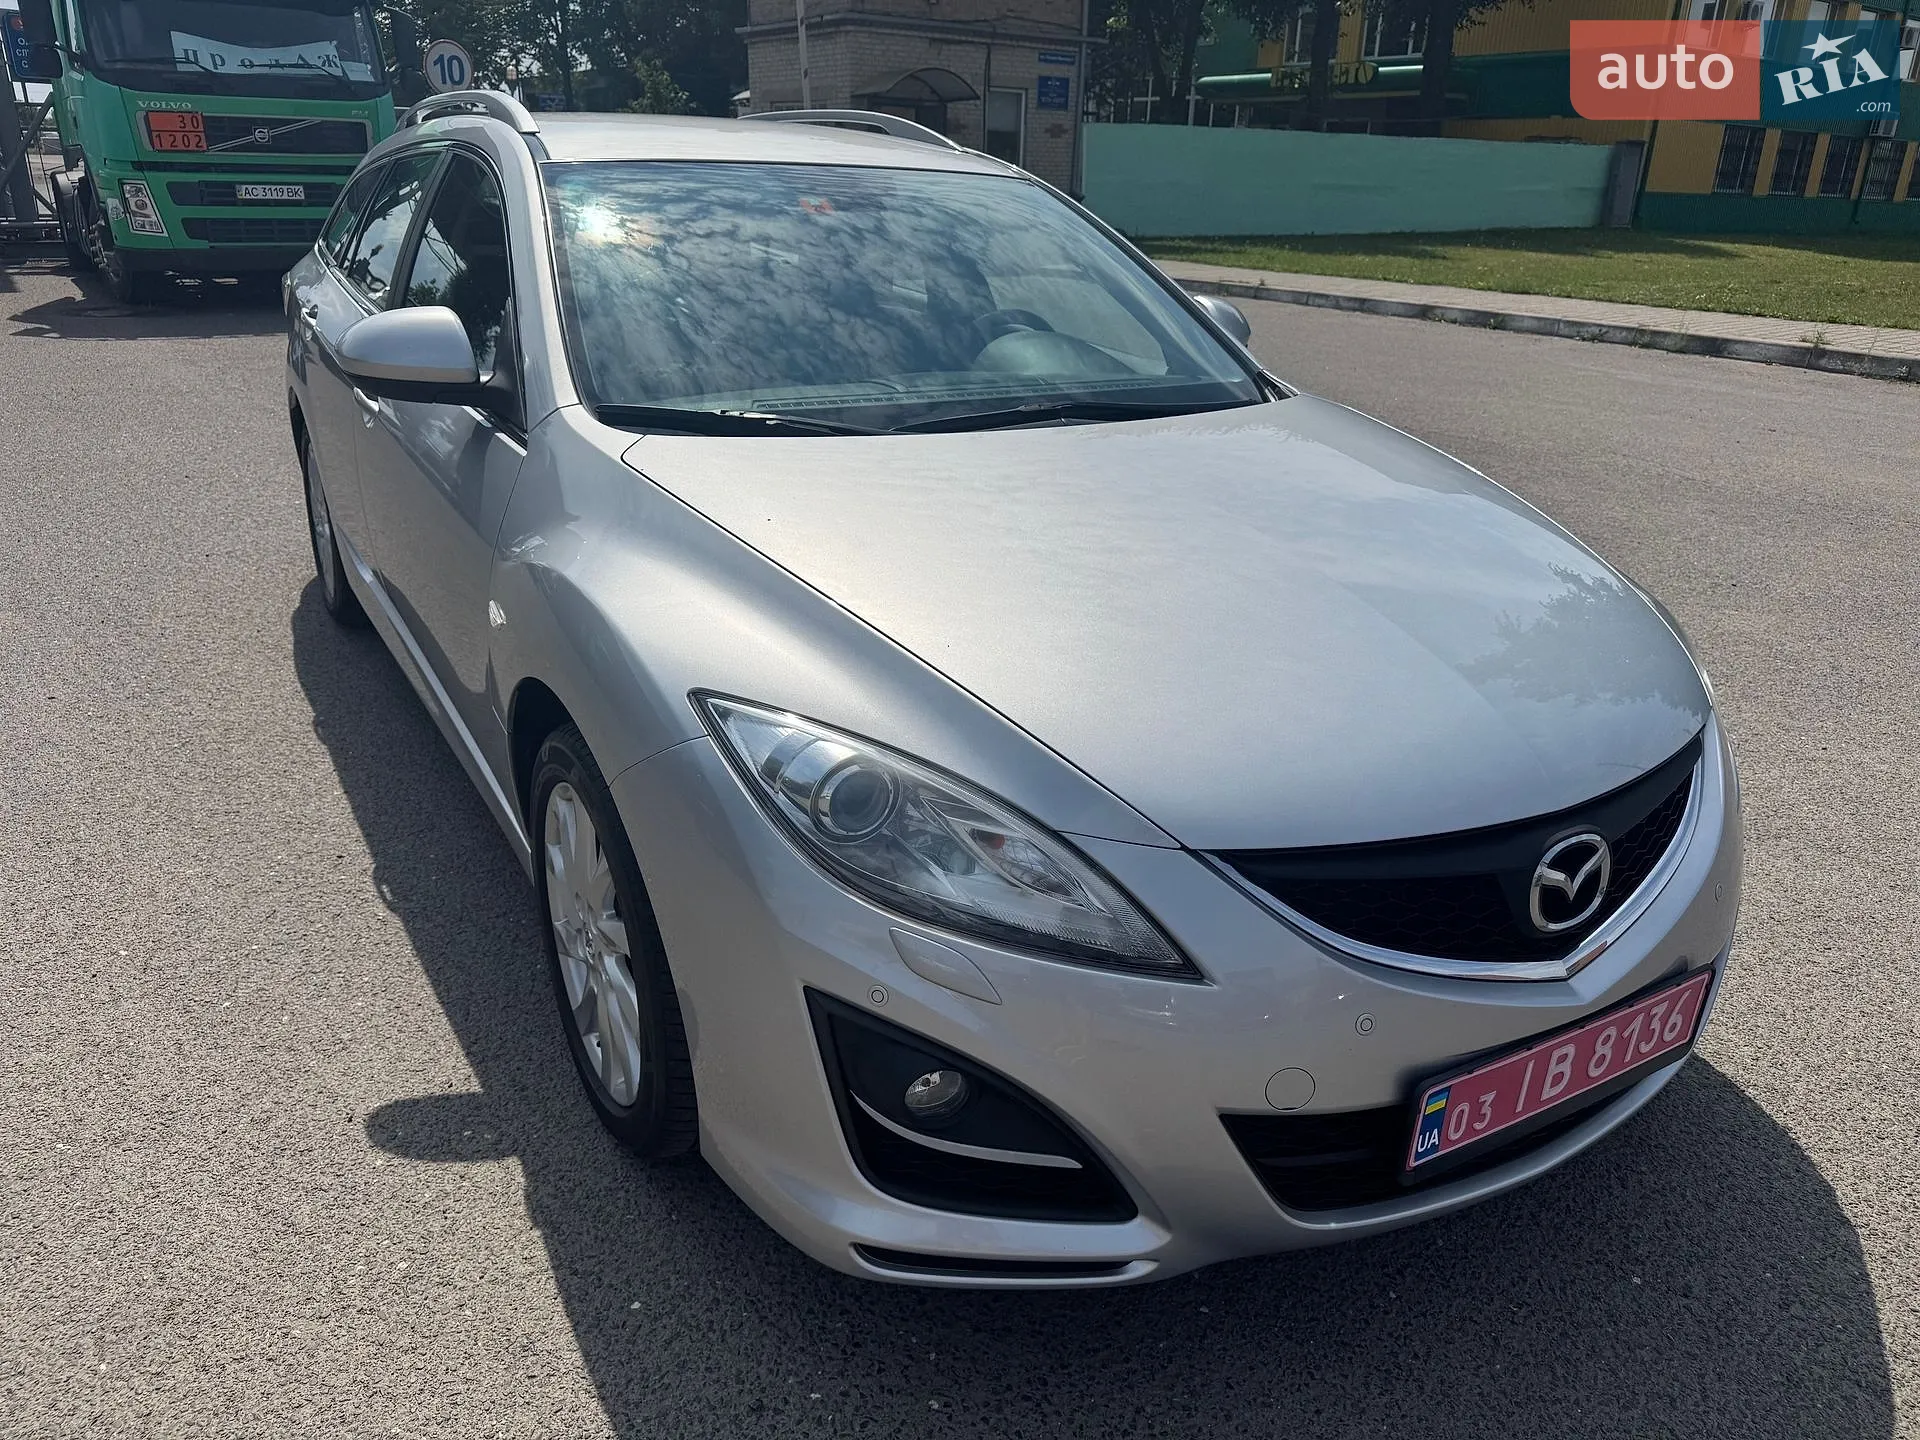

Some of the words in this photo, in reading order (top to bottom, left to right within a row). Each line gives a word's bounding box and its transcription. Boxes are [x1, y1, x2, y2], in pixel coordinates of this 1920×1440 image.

[433, 53, 465, 86] 10
[136, 100, 192, 109] VOLVO
[178, 115, 200, 130] 30
[154, 133, 204, 148] 1202
[243, 185, 259, 197] AC
[262, 186, 284, 197] 3119
[287, 187, 302, 198] BK
[1447, 1090, 1497, 1141] 03
[1588, 989, 1692, 1078] 8136
[1417, 1128, 1439, 1153] UA
